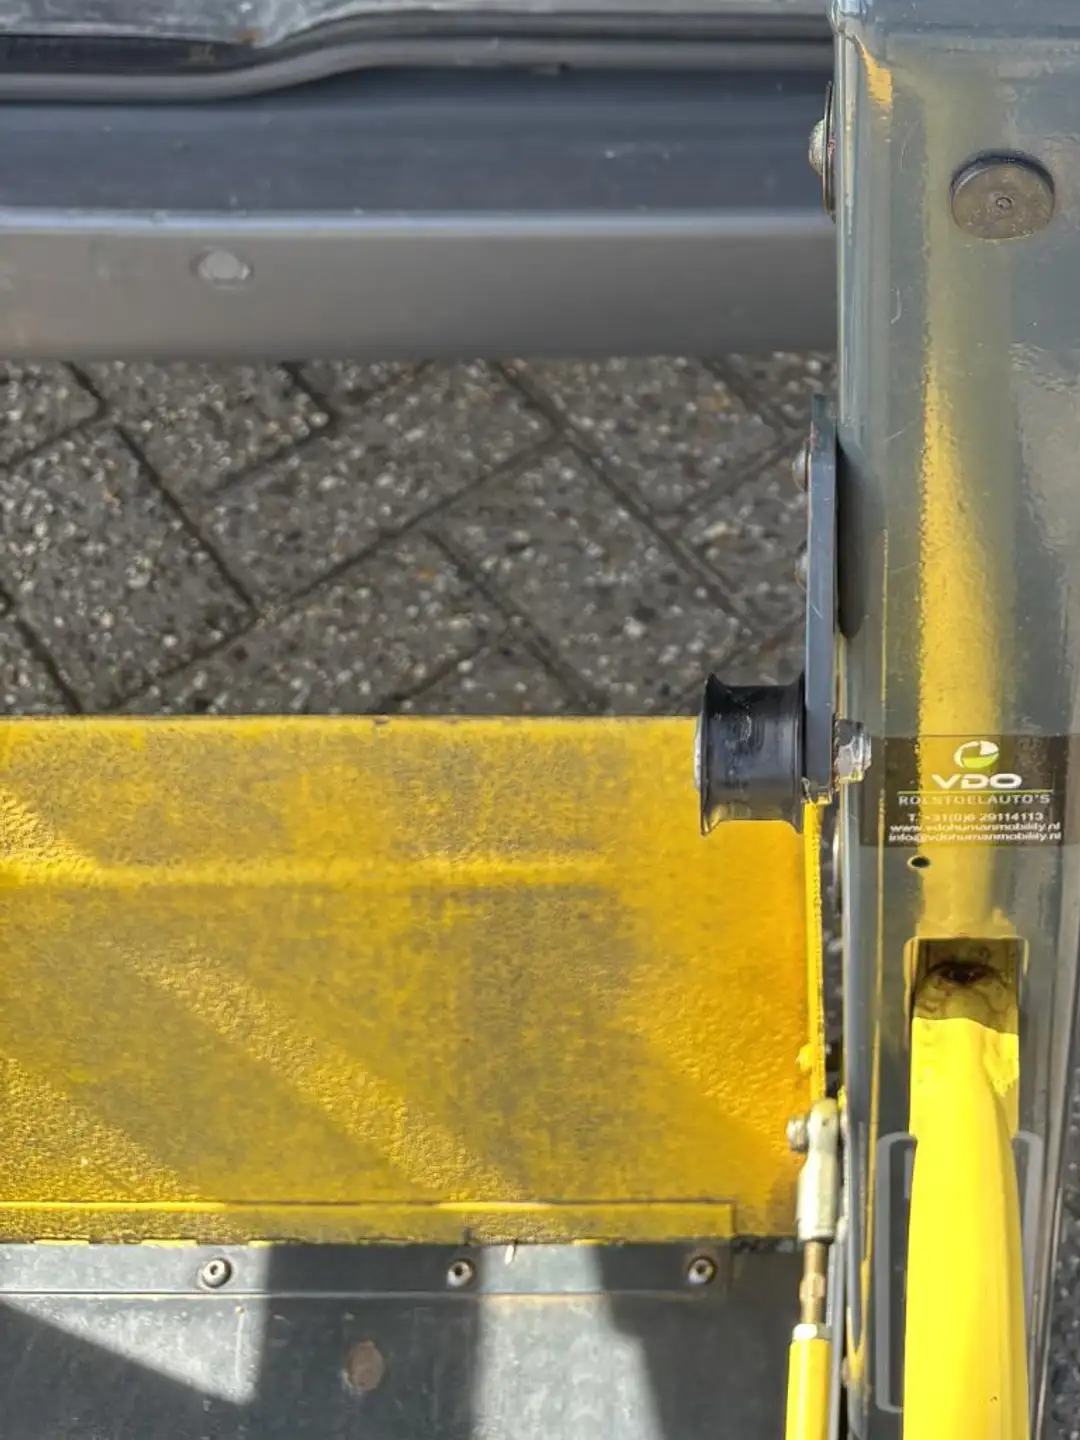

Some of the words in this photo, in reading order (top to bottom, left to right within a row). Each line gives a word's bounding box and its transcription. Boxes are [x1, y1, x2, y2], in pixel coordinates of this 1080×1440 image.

[931, 773, 1022, 789] VDO
[898, 794, 1051, 806] ROLSTOELAUTO'S
[979, 811, 1044, 822] 29114113
